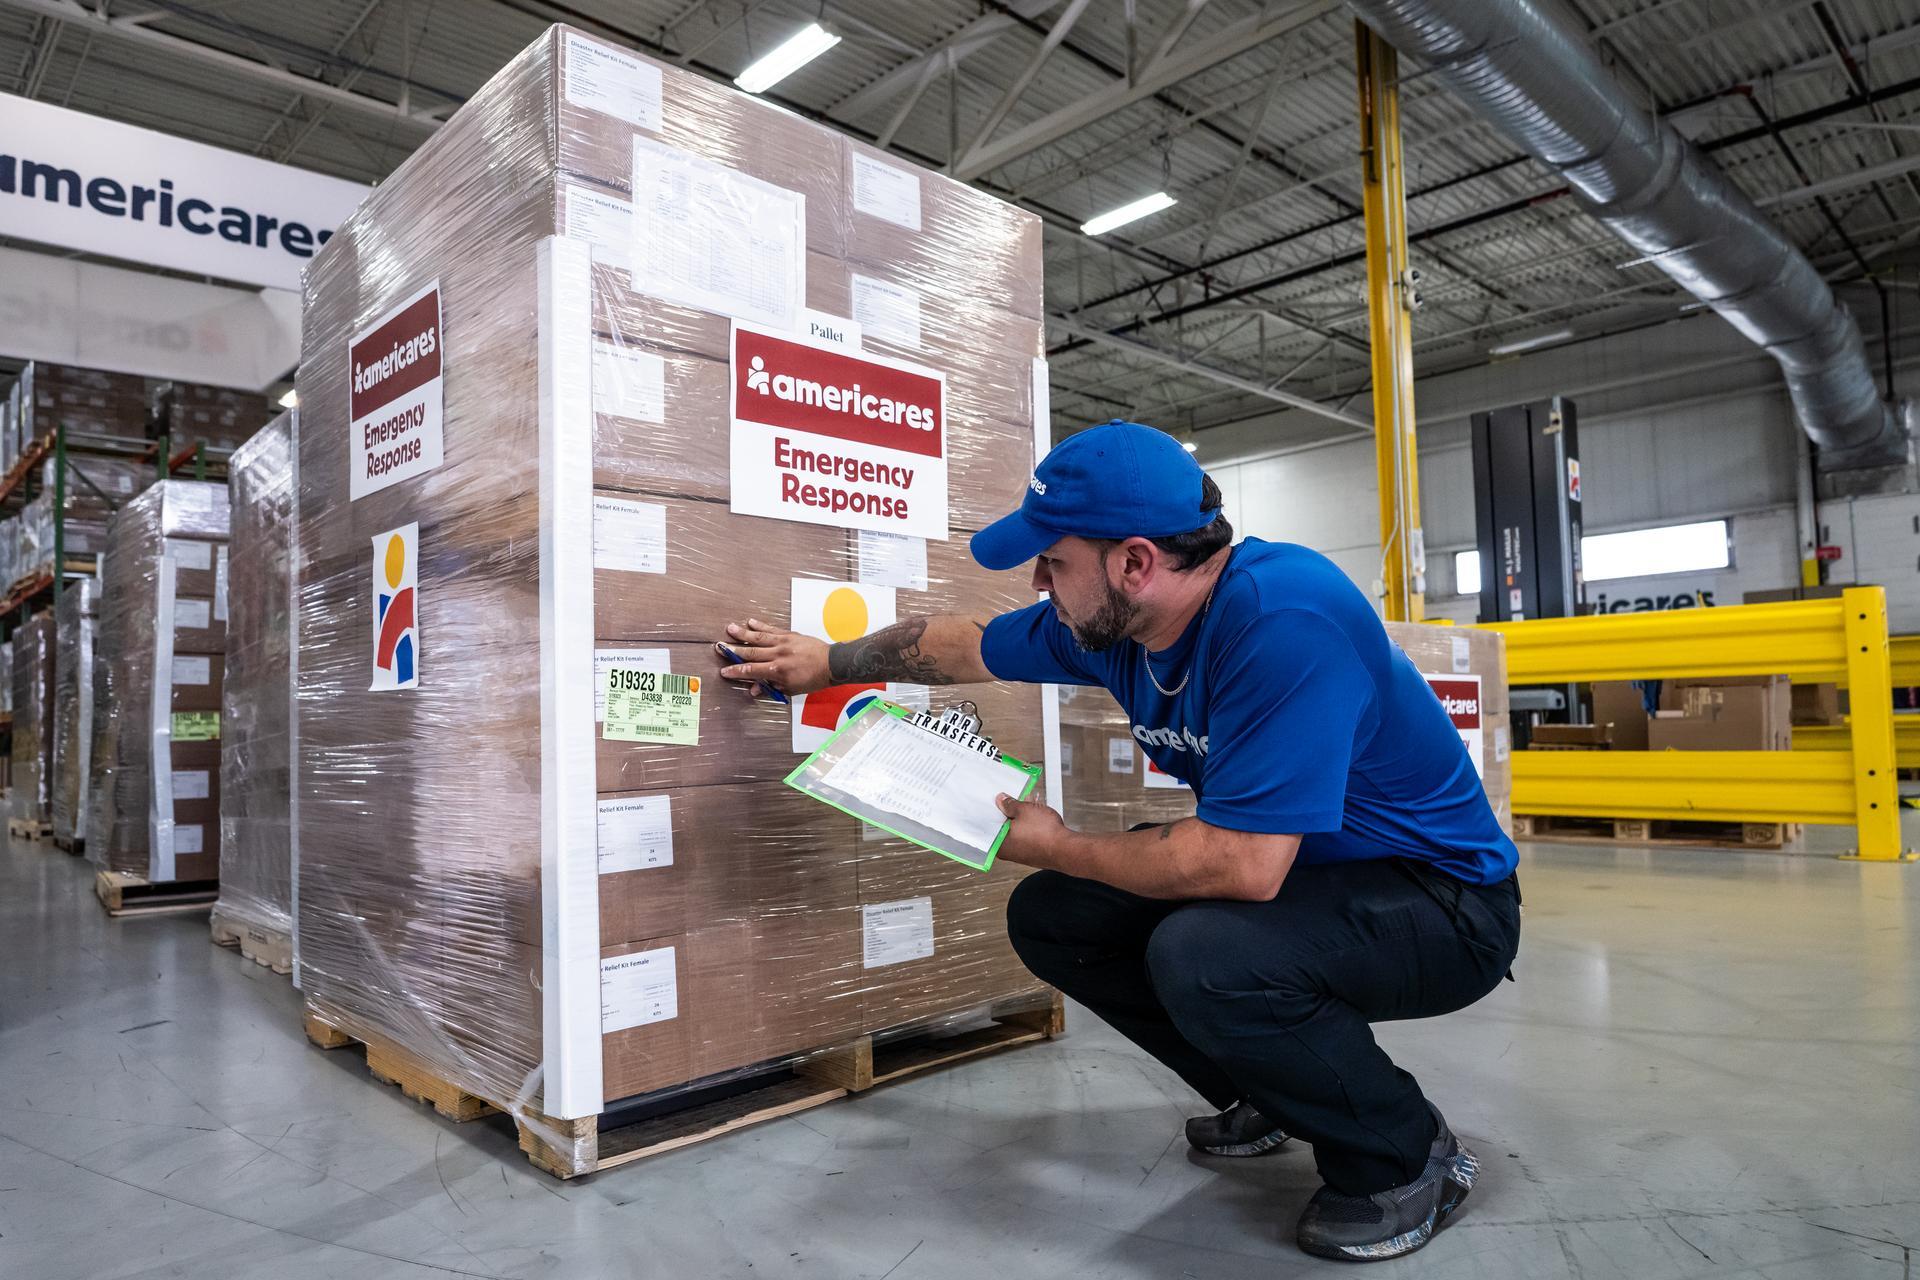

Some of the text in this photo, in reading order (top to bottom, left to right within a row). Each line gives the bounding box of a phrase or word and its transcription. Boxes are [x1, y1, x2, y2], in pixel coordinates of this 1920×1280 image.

[570, 40, 593, 53] Disaster
[594, 48, 610, 59] Relief
[810, 322, 844, 343] Pallet
[363, 326, 436, 391] americares
[772, 374, 935, 432] americares
[364, 402, 425, 450] Emergency
[366, 437, 421, 479] Response
[774, 436, 914, 490] Emergency
[781, 472, 908, 520] Response
[610, 669, 655, 691] 519323
[914, 713, 996, 758] TRANSFERS
[604, 964, 621, 972] Relief
[630, 959, 650, 967] Female
